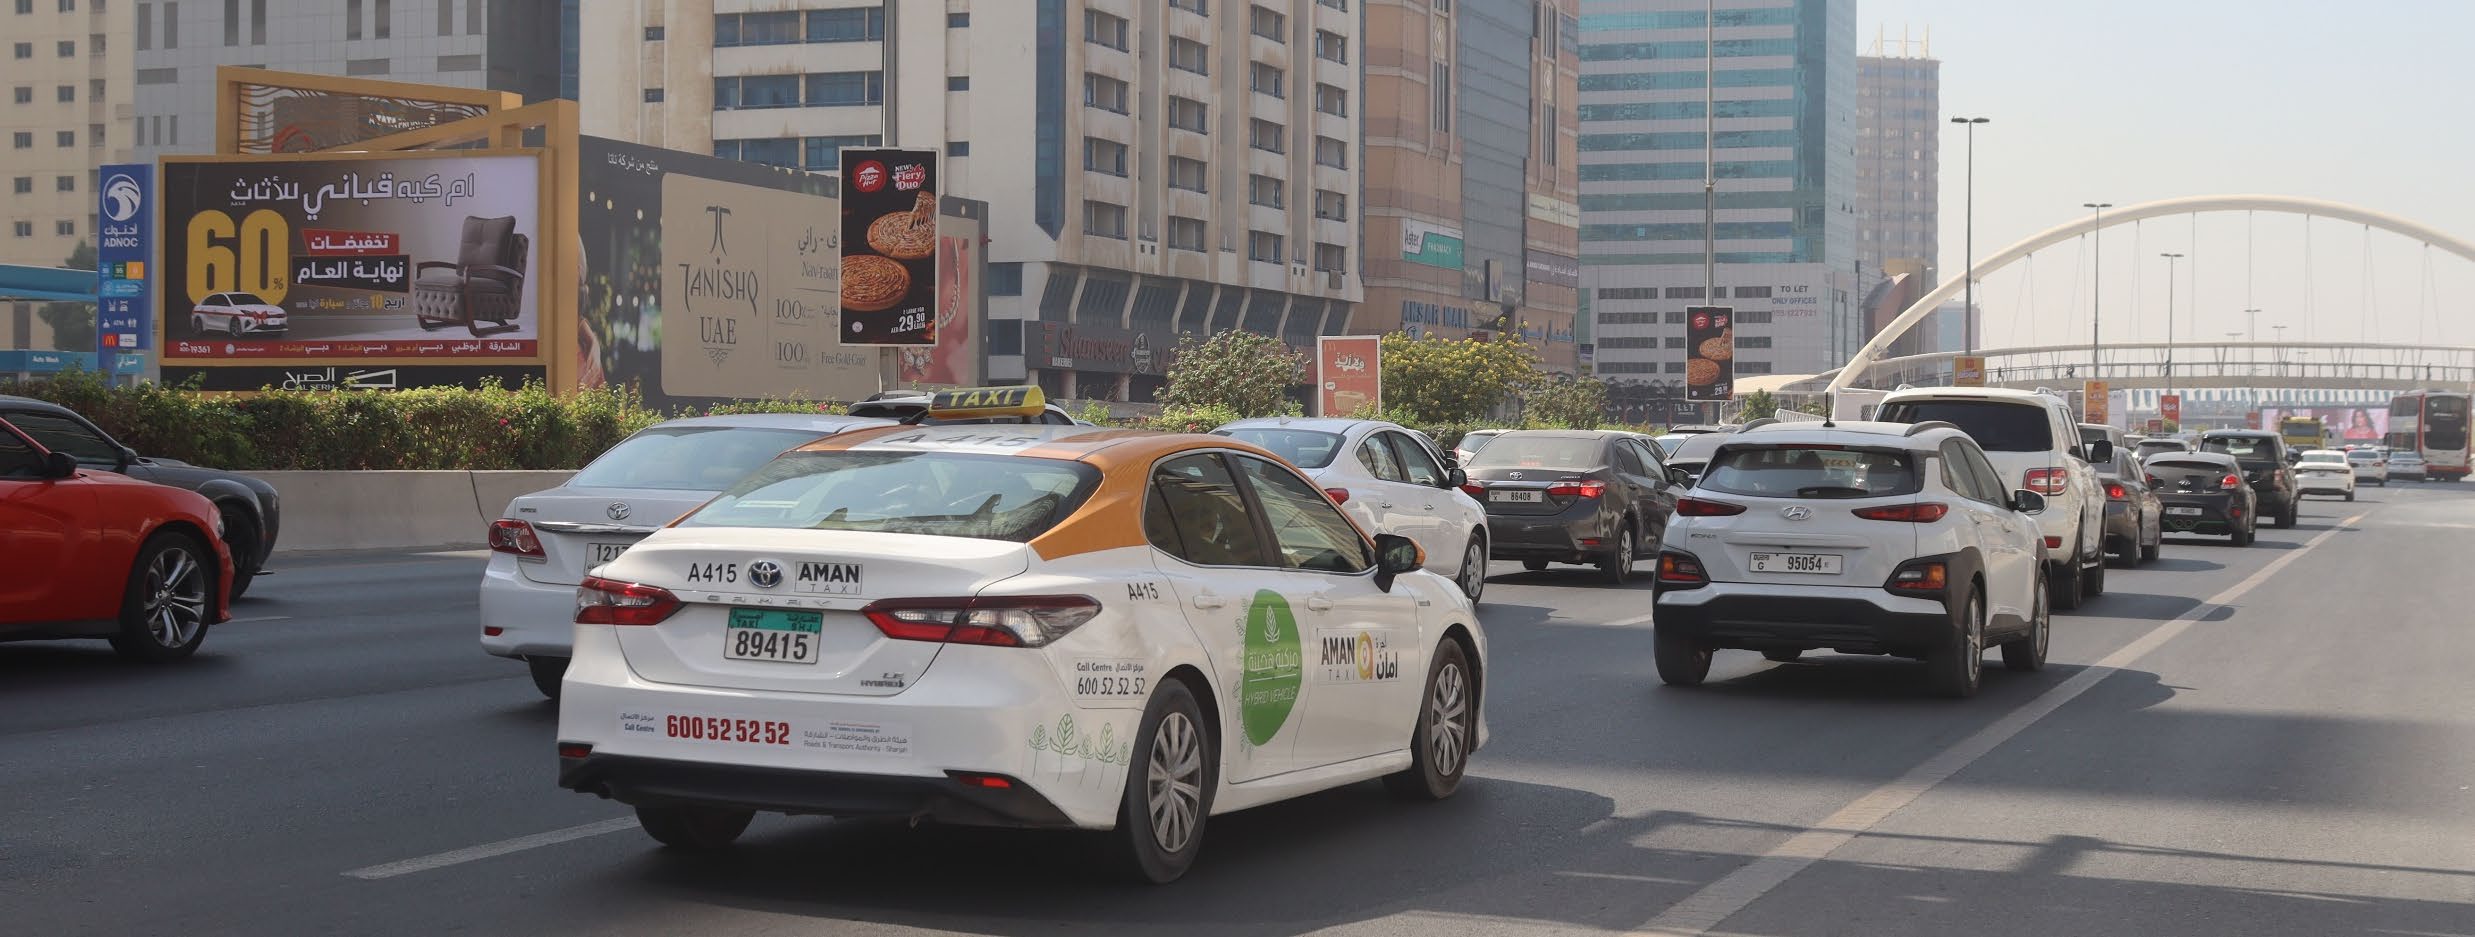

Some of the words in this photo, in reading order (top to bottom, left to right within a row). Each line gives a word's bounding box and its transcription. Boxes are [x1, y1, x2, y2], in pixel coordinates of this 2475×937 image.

[895, 171, 921, 181] Fiery
[896, 181, 919, 190] Duo
[303, 173, 393, 220] قباني
[104, 238, 138, 247] ADNOC
[311, 234, 389, 252] تخفيضات
[1405, 228, 1419, 246] Aster
[297, 261, 348, 283] العام
[353, 260, 404, 283] نهاية
[700, 317, 737, 345] UAE
[305, 344, 329, 354] دبي
[363, 343, 387, 354] دبي
[419, 343, 443, 353] دبي
[488, 342, 520, 352] الشارقة
[950, 390, 1014, 407] TAXI
[1757, 562, 1764, 570] G
[1787, 556, 1822, 571] 95054
[687, 563, 737, 583] A415
[799, 563, 859, 583] AMAN
[811, 584, 859, 594] TAXI
[1128, 582, 1159, 601] A415
[735, 630, 808, 660] 89415
[1321, 637, 1355, 665] AMAN
[1077, 662, 1090, 672] Call
[1092, 662, 1112, 672] Centre
[1328, 669, 1355, 680] TAXI
[1078, 677, 1098, 695] 600
[1101, 677, 1113, 695] 52
[1117, 677, 1129, 695] 52
[1133, 677, 1145, 695] 52
[1245, 689, 1269, 705] HYBRID
[1270, 686, 1296, 702] VEHICLE
[625, 722, 635, 731] Call
[636, 723, 655, 732] Centre
[667, 714, 704, 739] 600
[707, 717, 731, 741] 52
[736, 719, 760, 743] 52
[765, 721, 790, 745] 52
[829, 741, 853, 750] Transport
[855, 743, 880, 752] Authority
